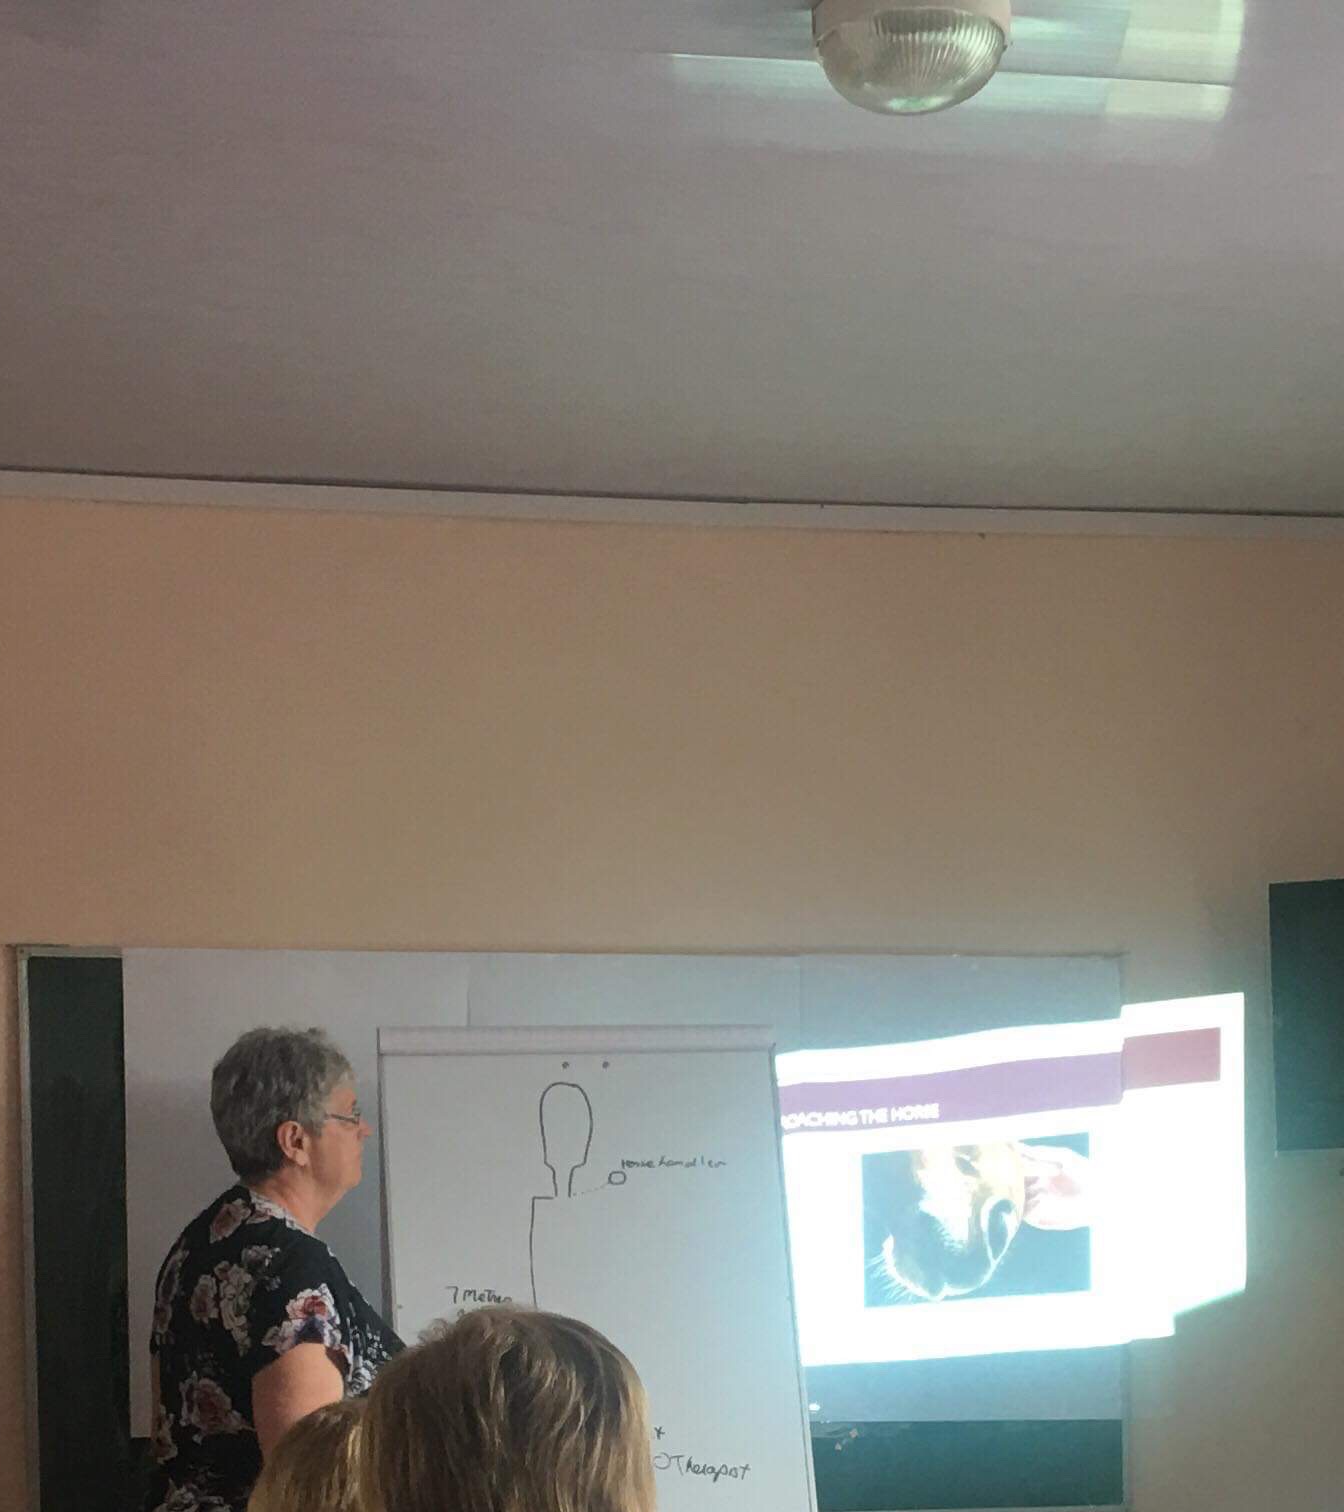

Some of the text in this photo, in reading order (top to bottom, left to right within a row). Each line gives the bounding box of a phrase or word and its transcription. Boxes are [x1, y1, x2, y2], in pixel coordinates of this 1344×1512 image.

[859, 1107, 889, 1125] THE
[891, 1102, 940, 1122] HORSE
[444, 1285, 460, 1305] 7
